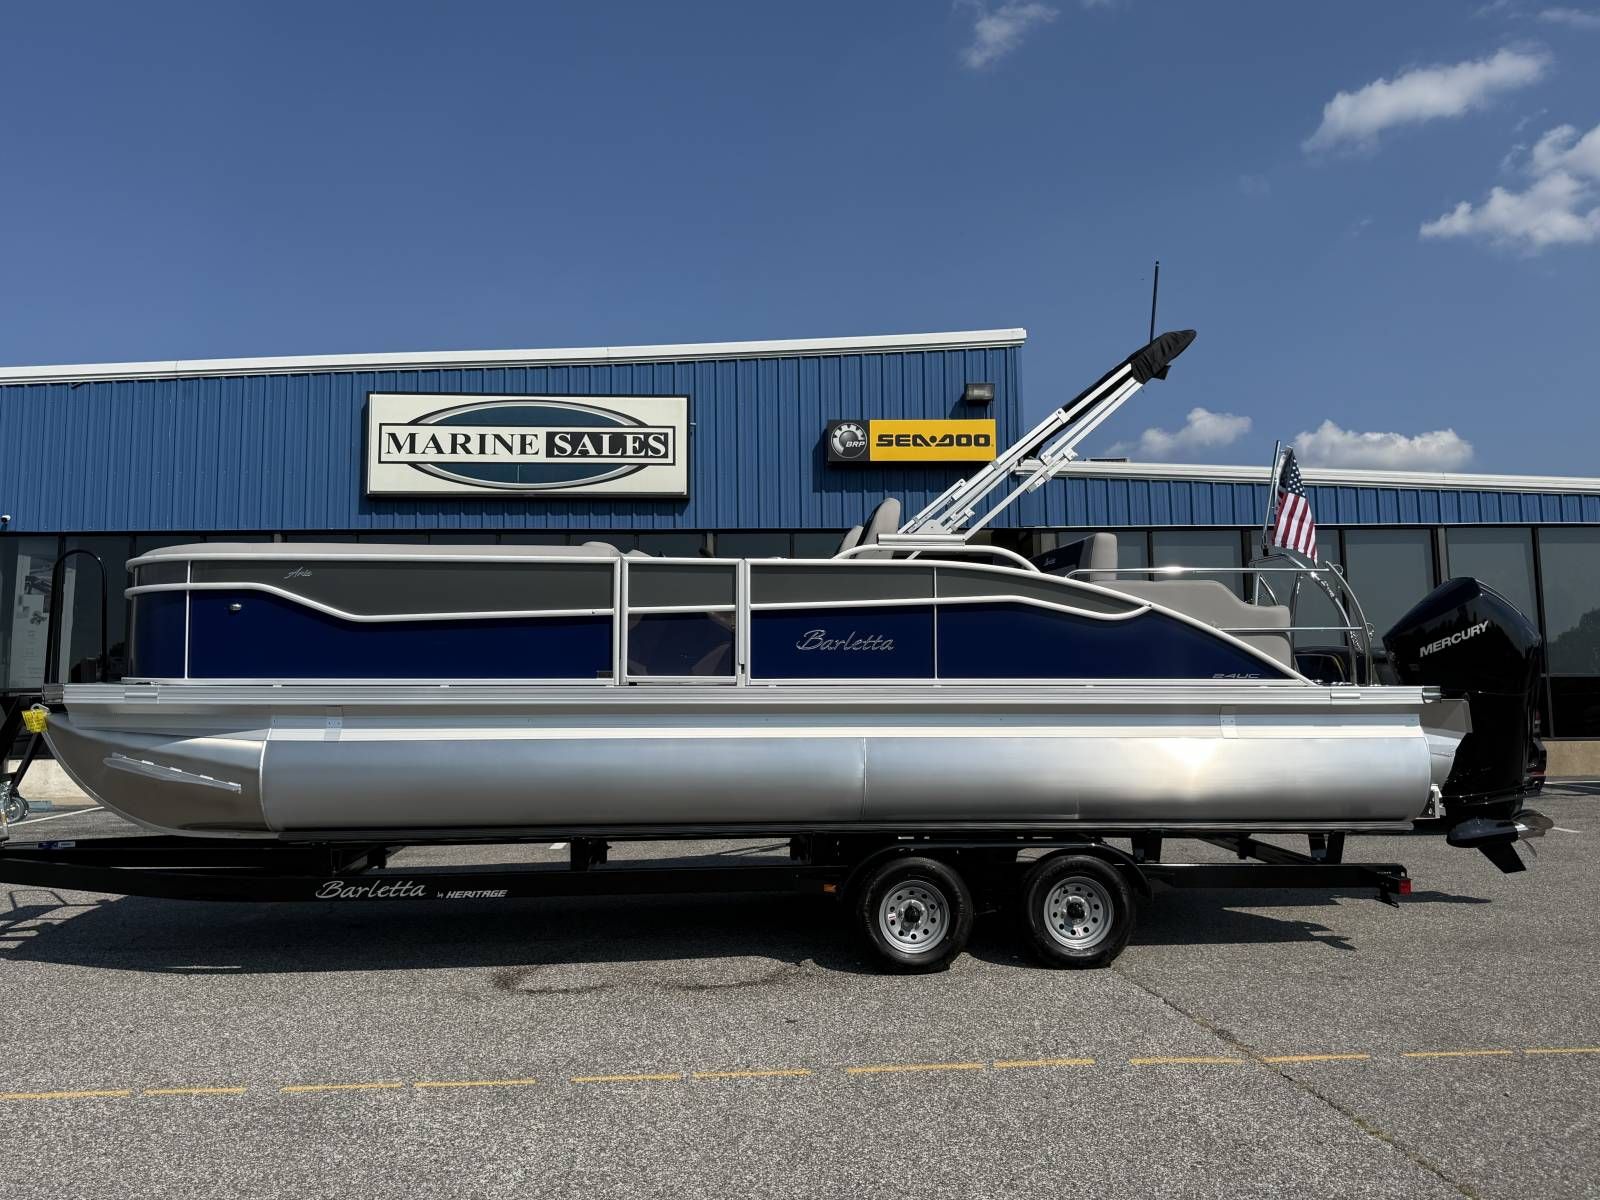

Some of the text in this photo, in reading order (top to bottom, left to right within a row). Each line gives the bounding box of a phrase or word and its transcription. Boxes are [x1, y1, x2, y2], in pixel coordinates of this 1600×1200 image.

[384, 431, 667, 457] MARINE SALES
[845, 440, 866, 448] BRP
[795, 629, 895, 651] Barletta
[1419, 620, 1489, 658] MERCURY
[315, 880, 427, 899] Barletta
[445, 889, 508, 899] HERITAGE
